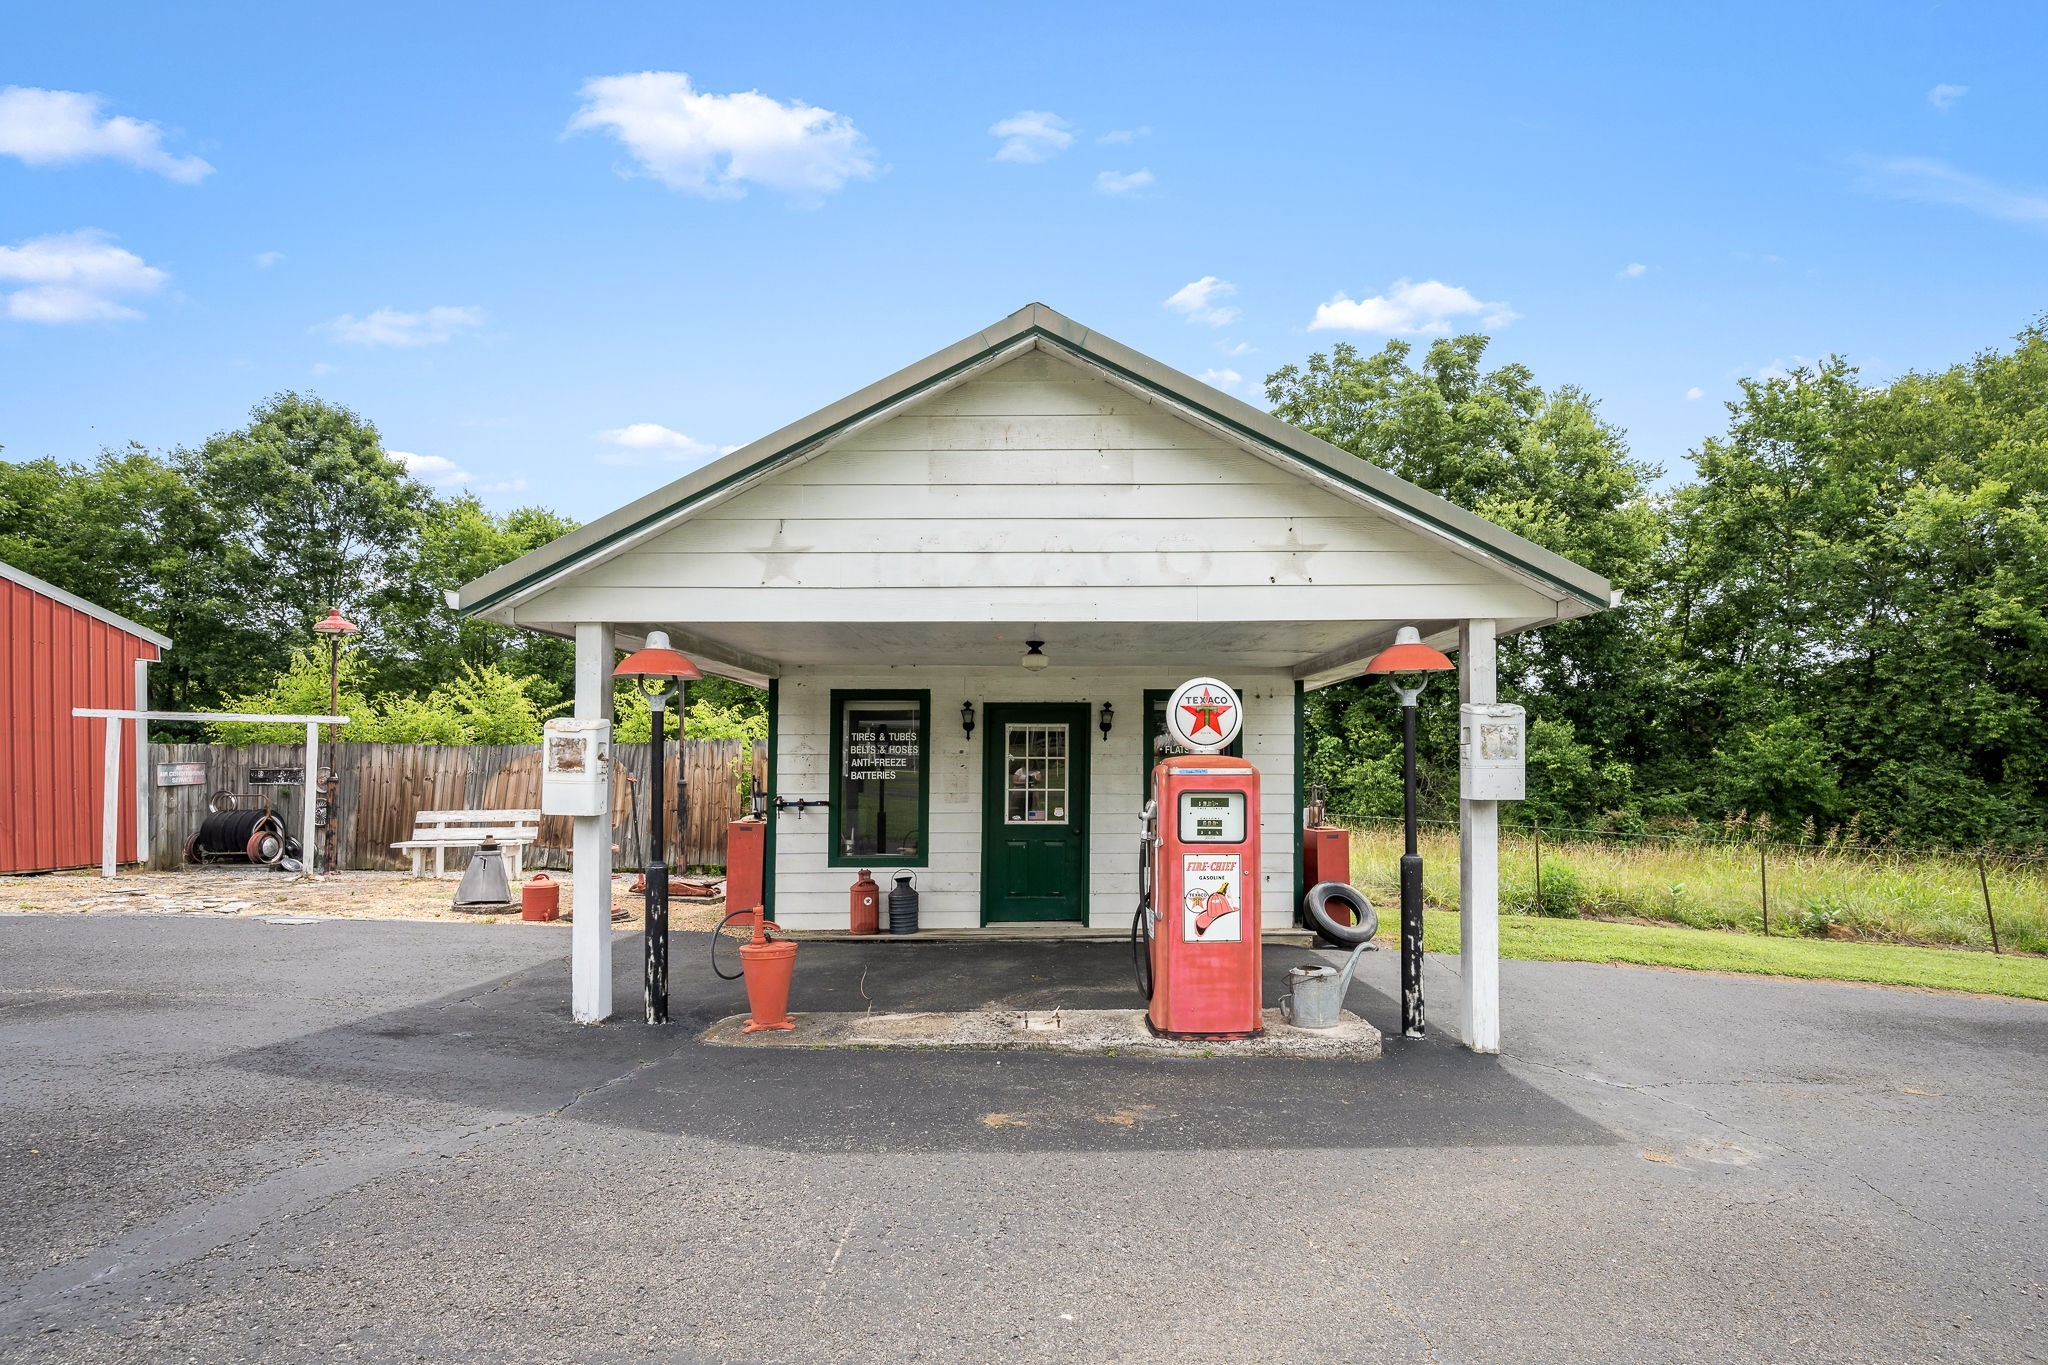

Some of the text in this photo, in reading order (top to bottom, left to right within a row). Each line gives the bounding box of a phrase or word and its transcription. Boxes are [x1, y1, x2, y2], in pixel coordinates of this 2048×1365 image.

[1185, 696, 1228, 704] TEXACO
[851, 732, 917, 741] TIRES & TUBES
[850, 745, 919, 754] BELTS & HOSES
[851, 758, 907, 767] ANTI-FREEZE
[850, 771, 896, 780] BATTERIES
[1186, 861, 1237, 872] FIRE-CHIEF
